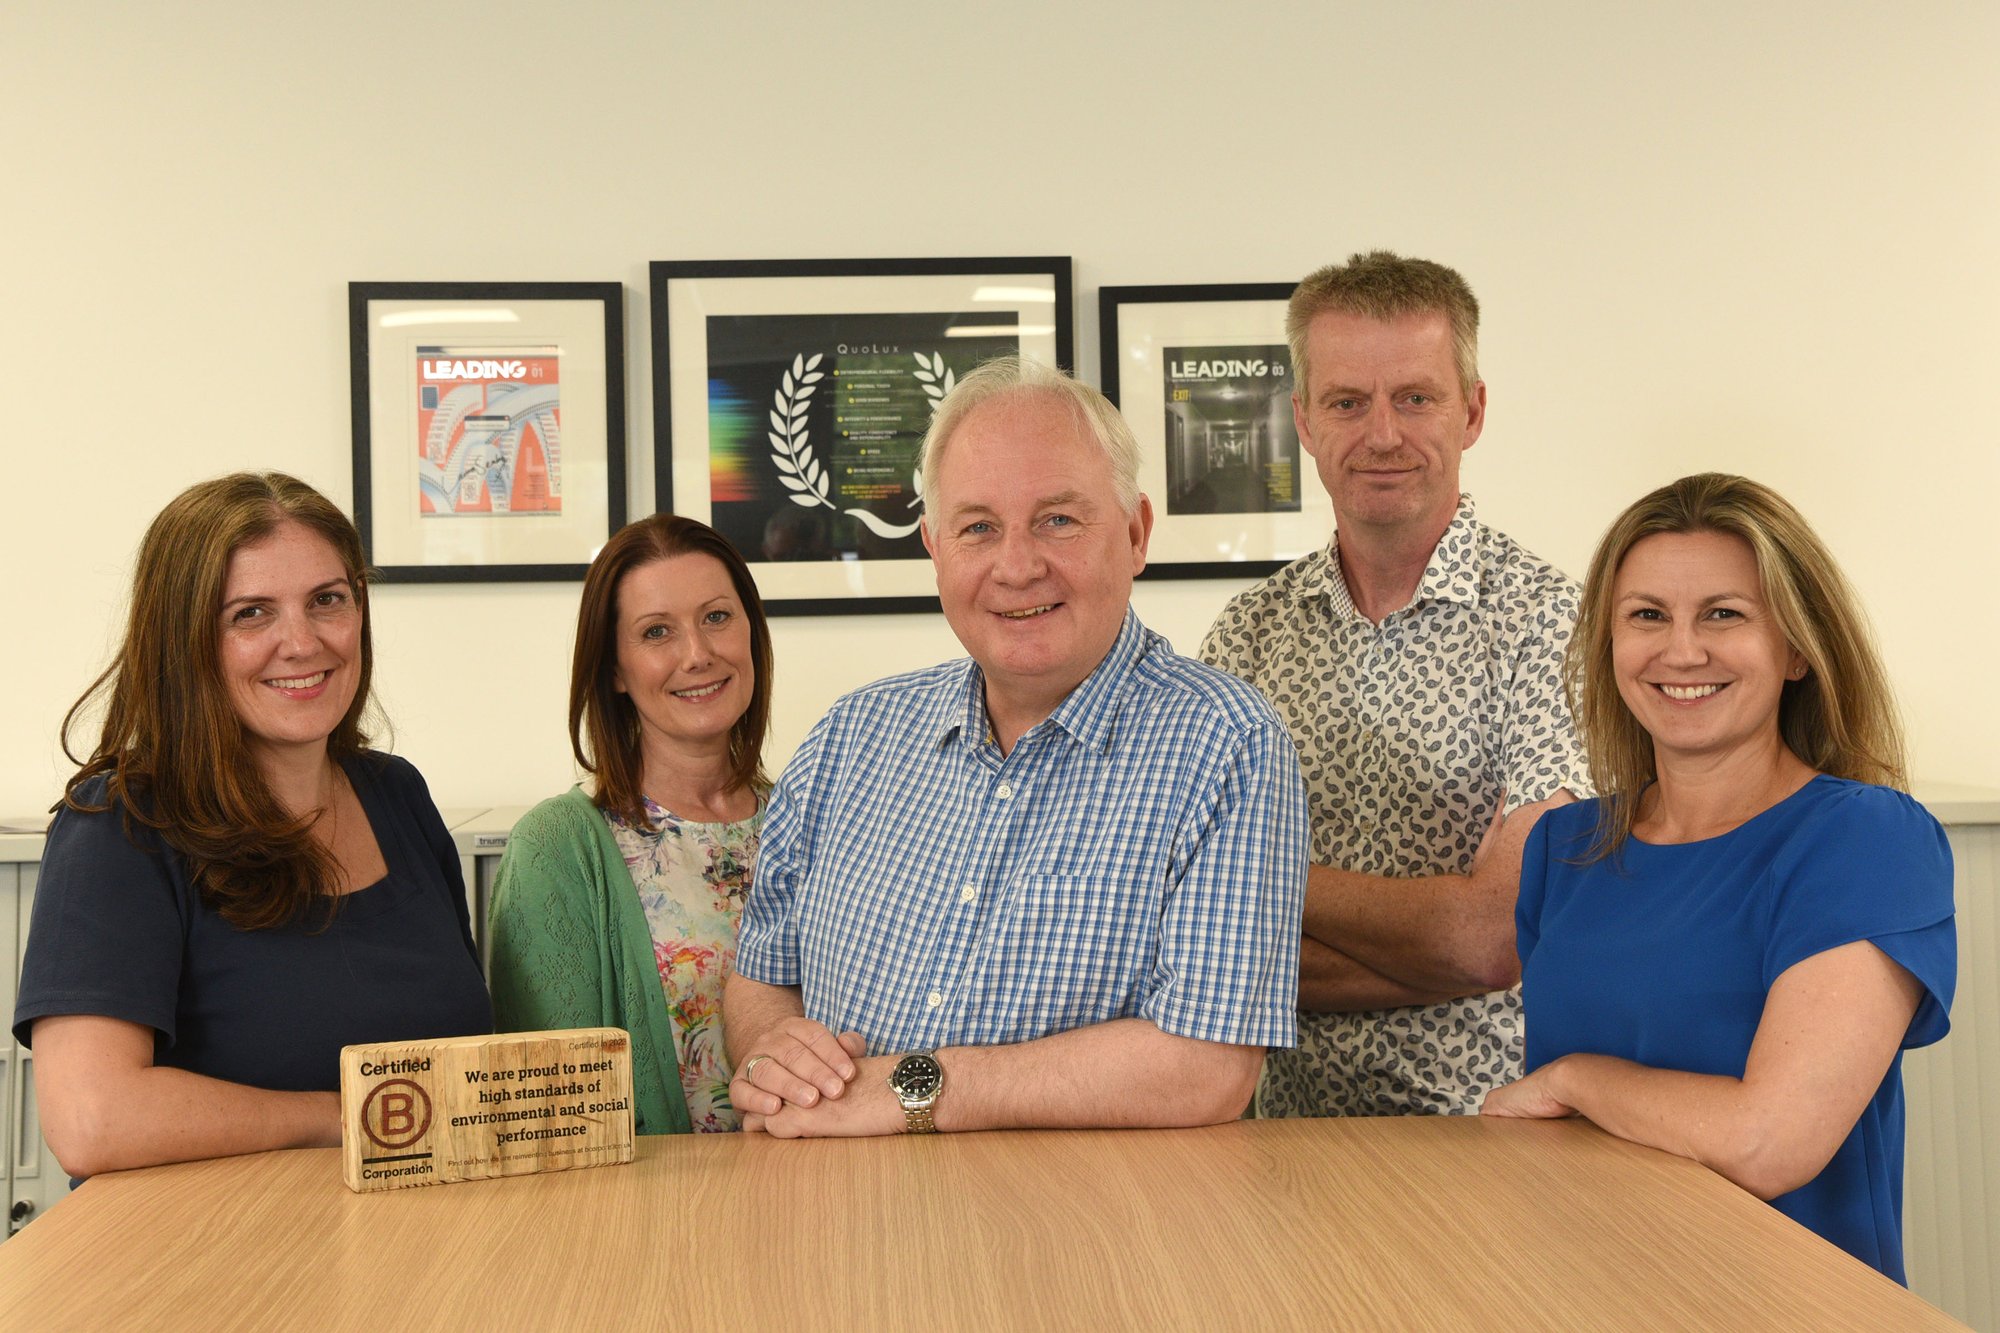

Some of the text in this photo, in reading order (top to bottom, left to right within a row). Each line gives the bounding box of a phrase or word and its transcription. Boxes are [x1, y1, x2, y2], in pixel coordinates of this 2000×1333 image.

[423, 360, 543, 379] LEADING 01
[1171, 359, 1284, 378] LEADING 03
[568, 1040, 600, 1050] Certified
[360, 1058, 431, 1076] Certified
[465, 1059, 613, 1083] We are proud to meet
[479, 1080, 601, 1104] high standards of
[382, 1093, 414, 1136] B
[451, 1098, 628, 1127] environmental and social
[496, 1125, 587, 1146] performance
[362, 1164, 433, 1180] Corporation
